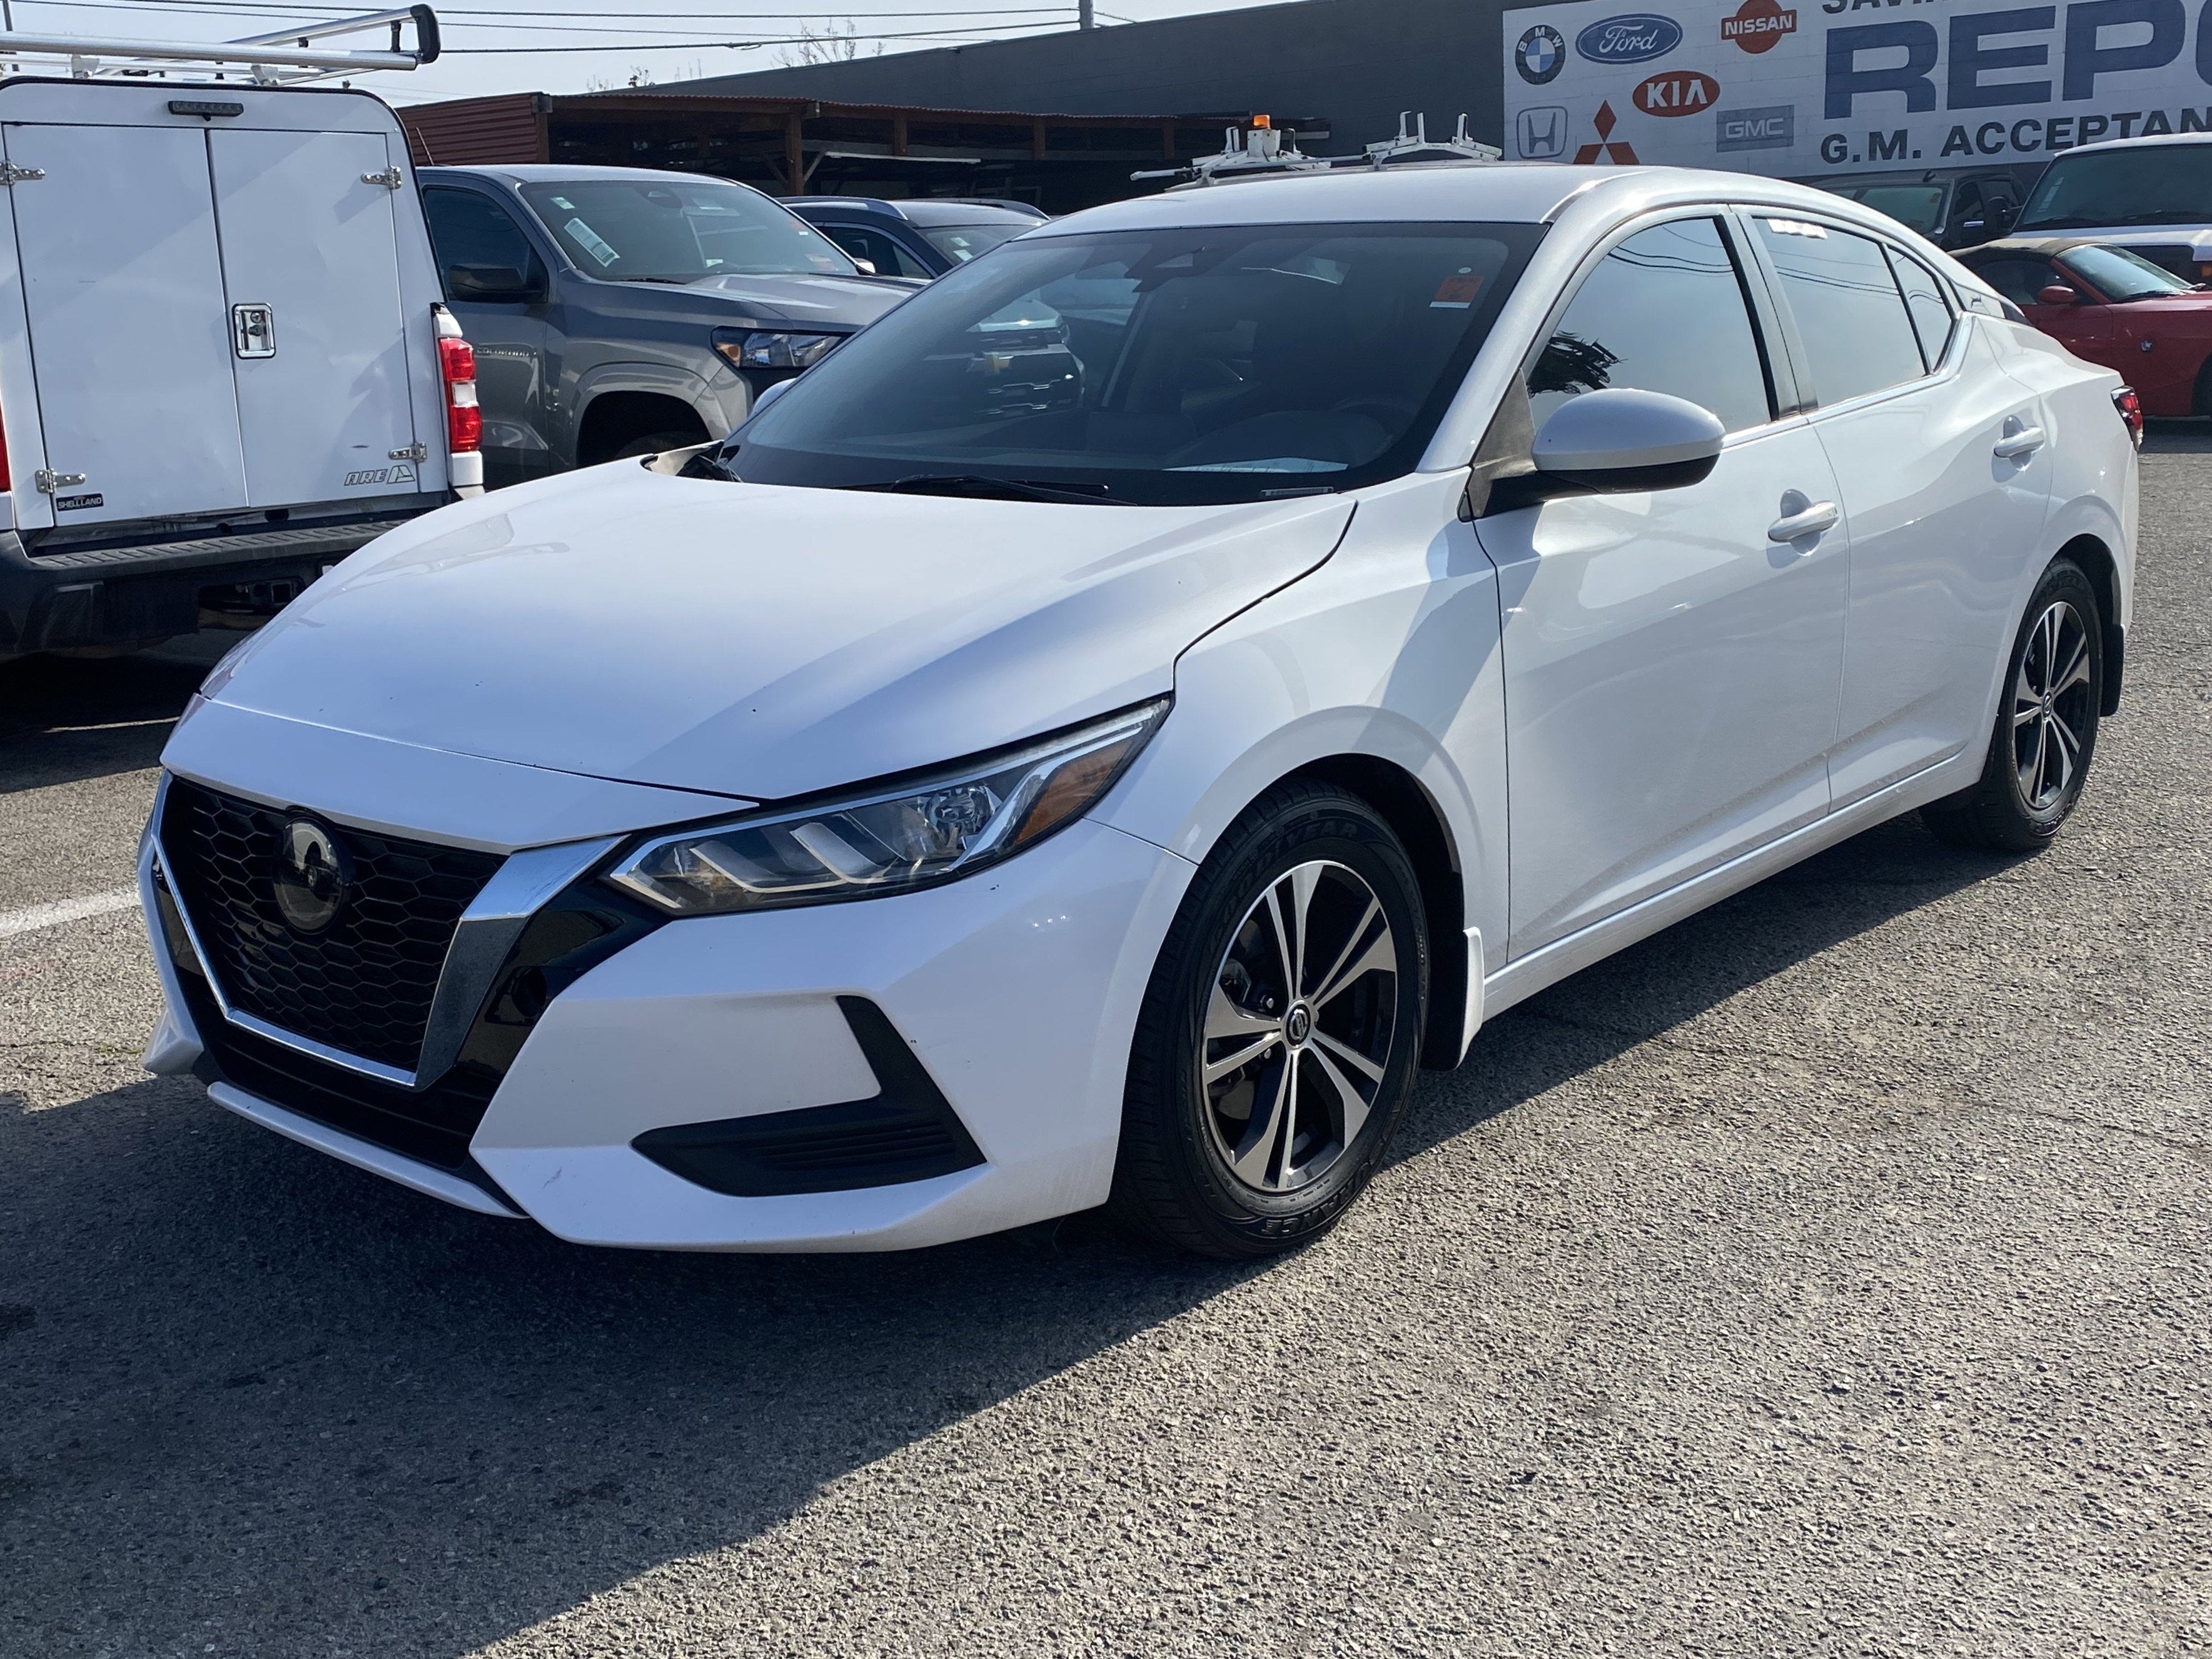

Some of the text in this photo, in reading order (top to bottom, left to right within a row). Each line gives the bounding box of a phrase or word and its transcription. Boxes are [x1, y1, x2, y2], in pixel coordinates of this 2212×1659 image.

[1725, 14, 1792, 36] NISSAN
[1518, 26, 1563, 52] BMW
[1599, 25, 1658, 53] Ford
[1824, 0, 2212, 119] REP
[1646, 79, 1708, 108] KIA
[1725, 118, 1784, 138] GMC
[1821, 129, 1921, 164] G.M.
[344, 468, 388, 486] ARE
